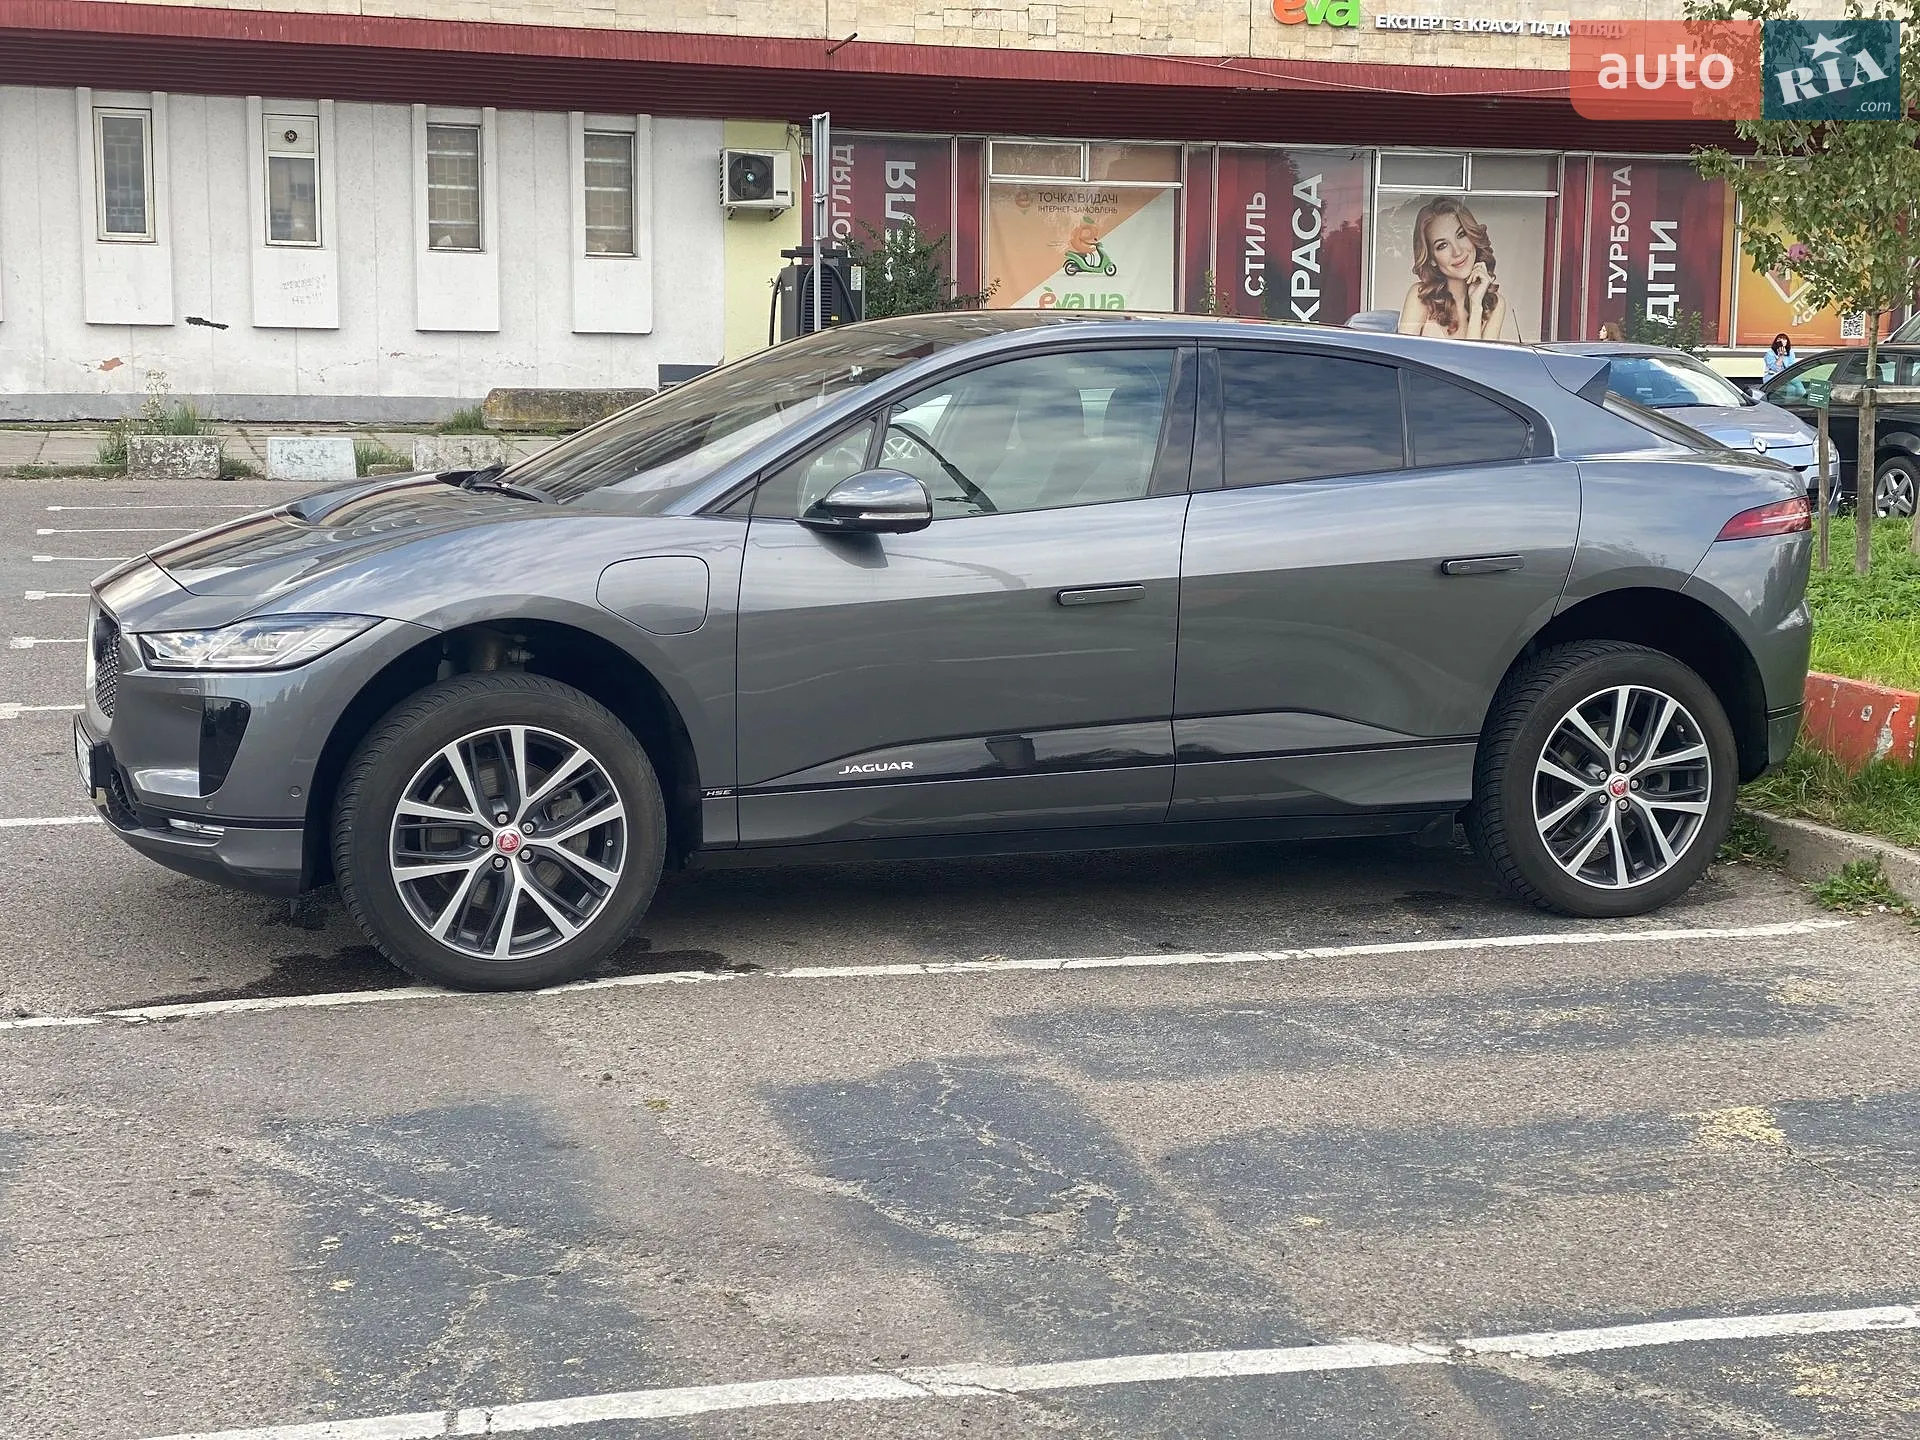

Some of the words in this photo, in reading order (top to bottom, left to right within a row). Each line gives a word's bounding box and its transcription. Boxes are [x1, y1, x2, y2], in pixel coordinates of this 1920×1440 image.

[1375, 14, 1449, 31] ЕКСПЕРТ
[1467, 17, 1524, 33] КРАСИ
[1528, 21, 1548, 34] ТА
[1552, 20, 1630, 38] ДОГЛЯДУ
[1038, 191, 1075, 204] ТОЧКА
[1077, 192, 1118, 205] ВИДАЧІ
[1038, 204, 1118, 215] ІНТЕРНЕТ-ЗАМОВЛЕНЬ
[1607, 164, 1632, 299] ТУРБОТА
[1244, 191, 1266, 297] СТИЛЬ
[1290, 173, 1323, 324] КРАСА
[1646, 220, 1680, 328] ДІТИ
[1038, 289, 1125, 310] evaua
[838, 761, 914, 775] JAGUAR
[706, 789, 733, 797] HSE
